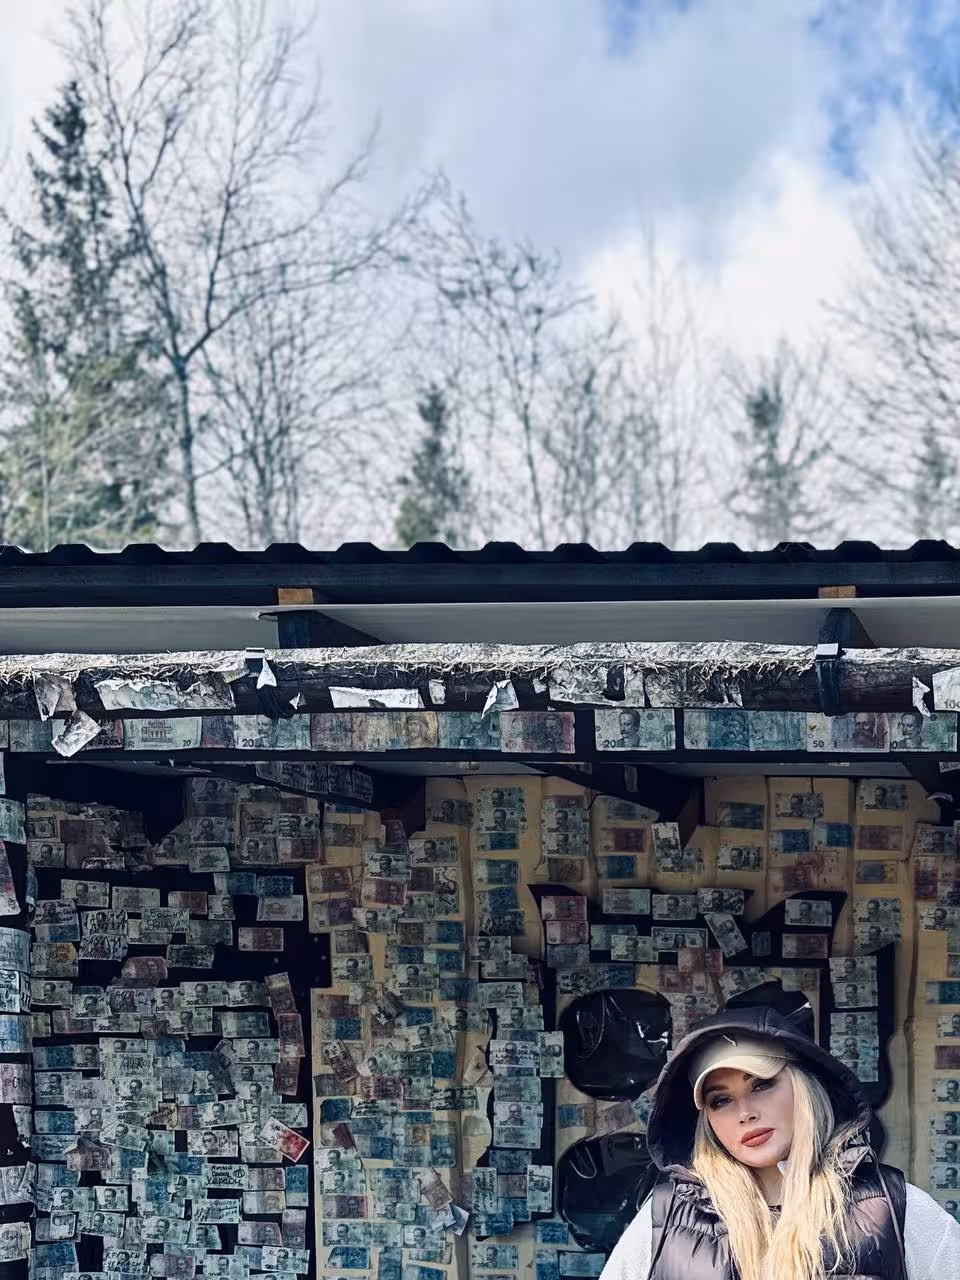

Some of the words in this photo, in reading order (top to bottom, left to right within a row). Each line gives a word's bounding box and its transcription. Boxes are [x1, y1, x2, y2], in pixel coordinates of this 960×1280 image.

[242, 739, 254, 747] 20
[604, 739, 616, 748] 20
[813, 739, 824, 748] 50
